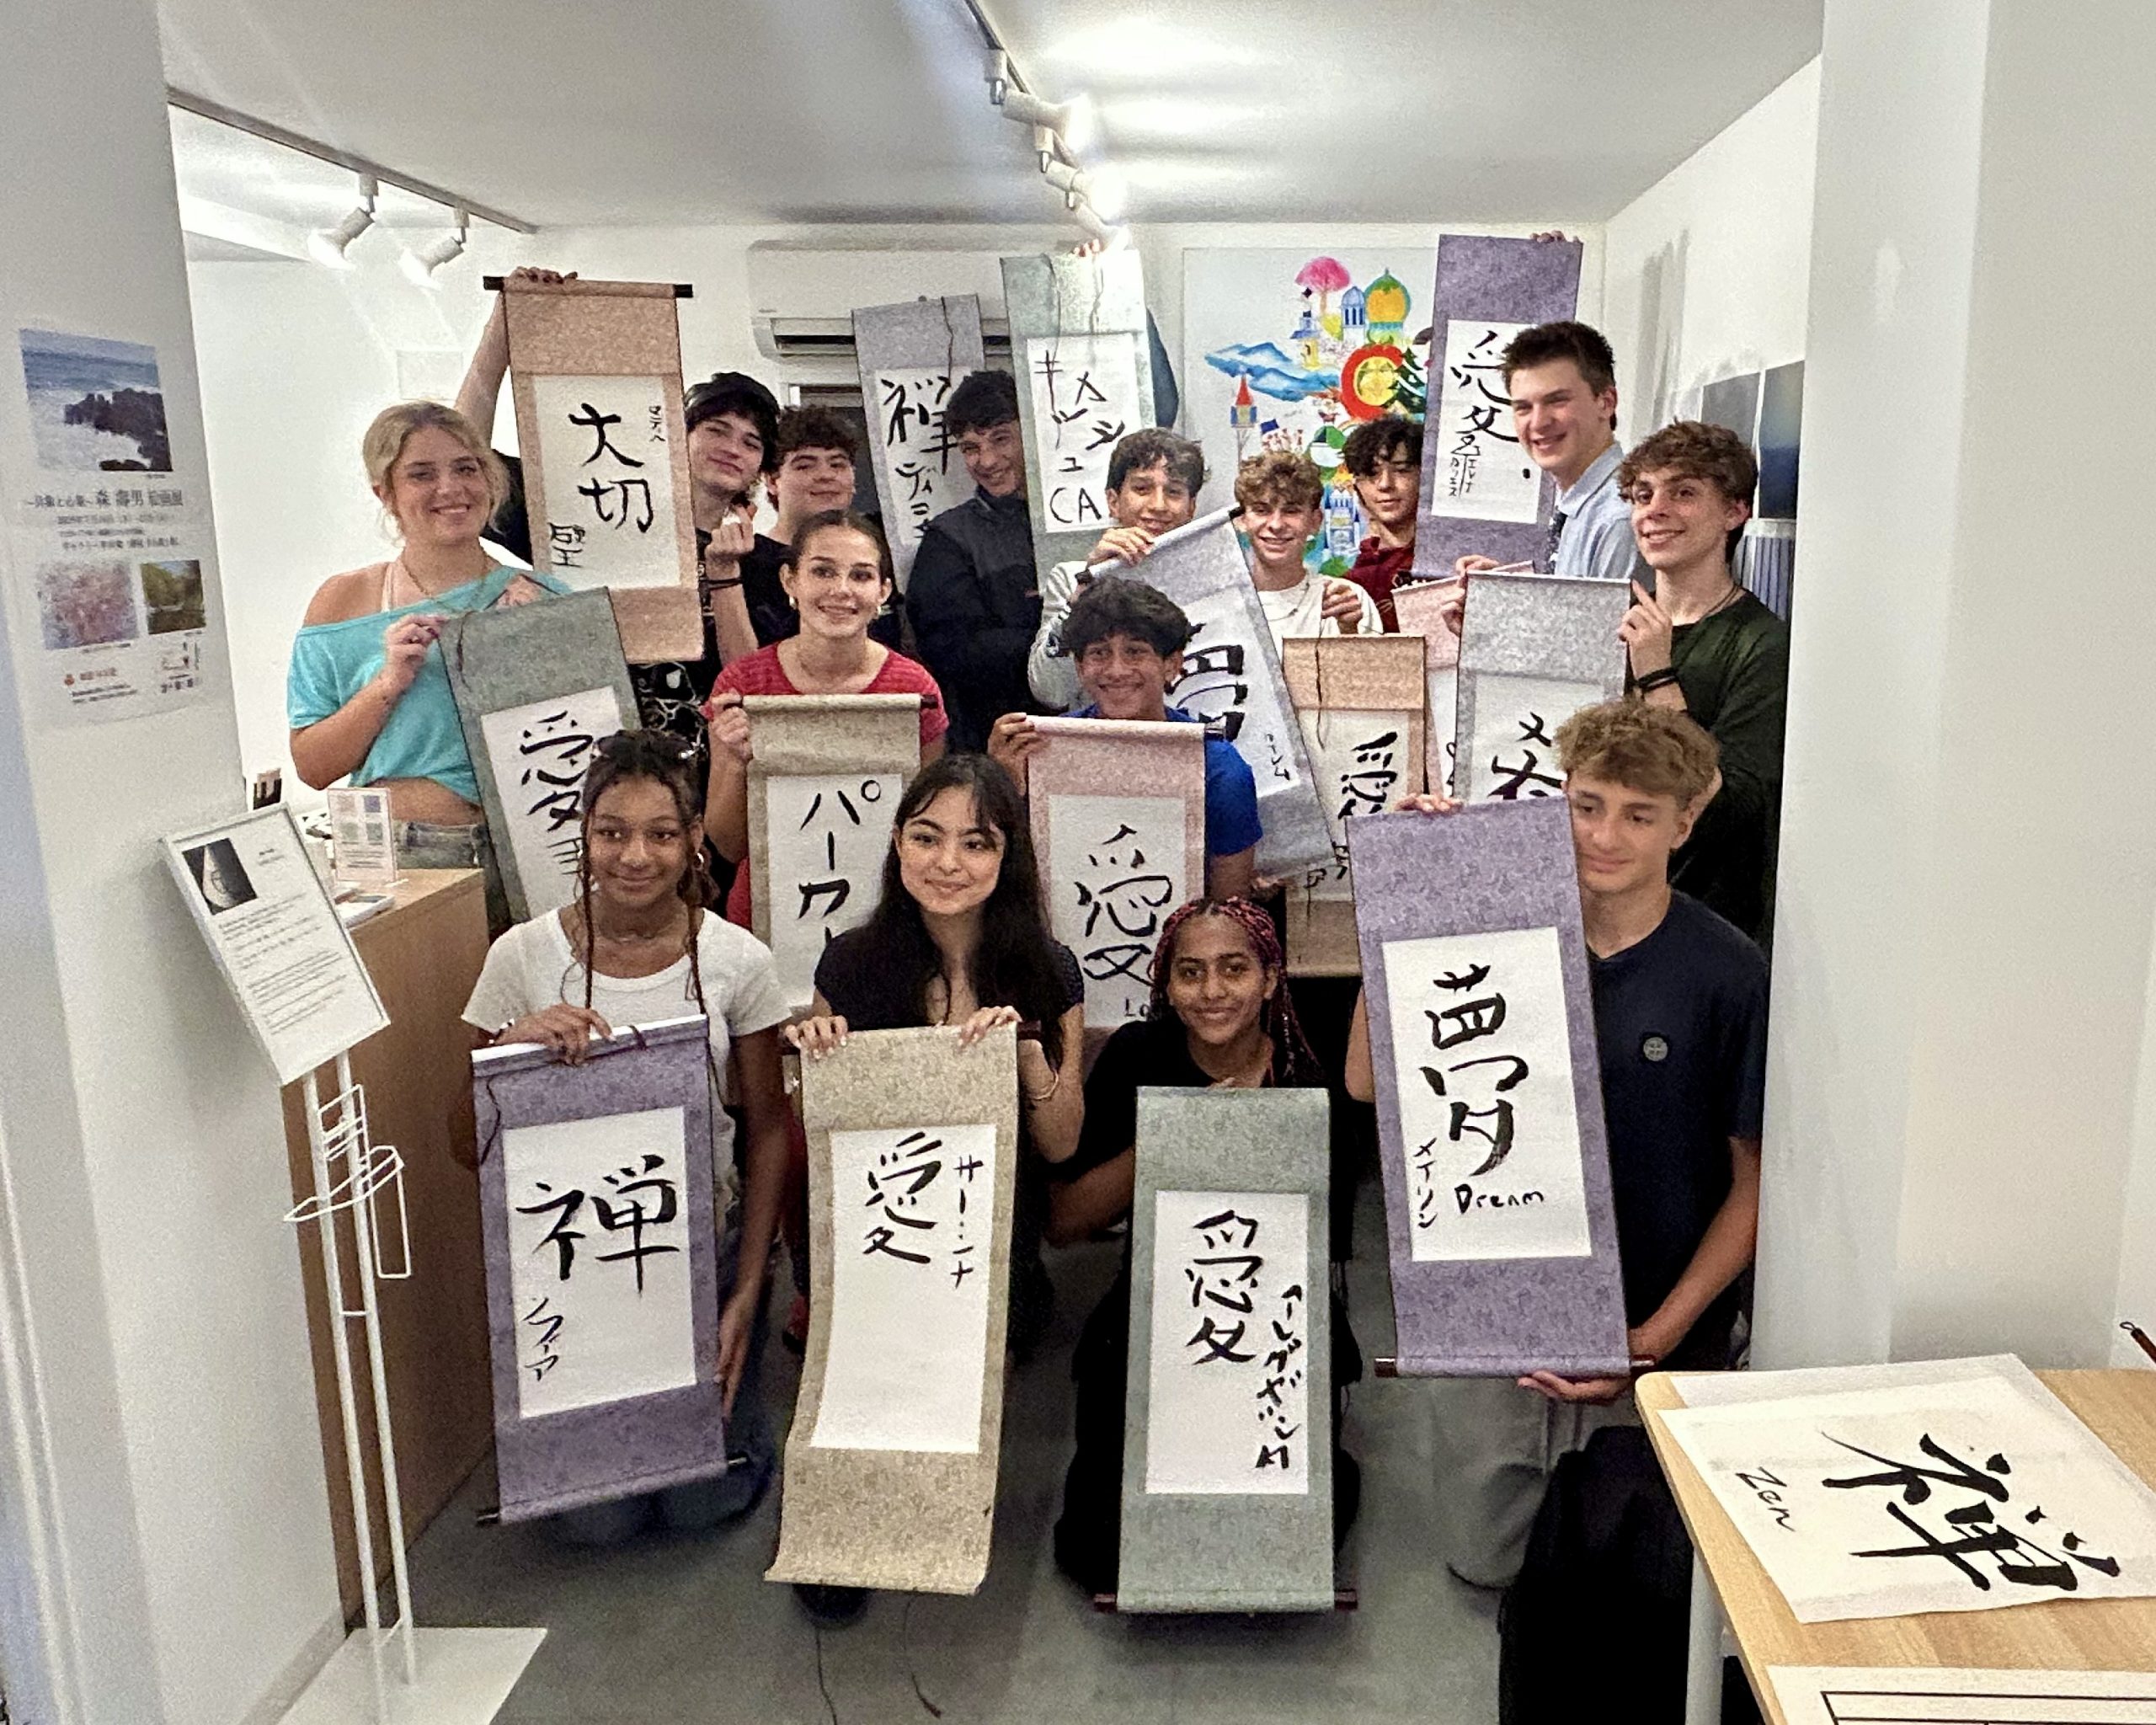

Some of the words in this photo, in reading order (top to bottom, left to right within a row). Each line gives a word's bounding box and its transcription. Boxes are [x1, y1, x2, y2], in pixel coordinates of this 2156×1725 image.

[568, 403, 654, 533] 大切
[1049, 487, 1102, 524] CA
[1075, 823, 1172, 985] 愛
[1123, 998, 1150, 1017] Lo
[1419, 964, 1529, 1176] 夢
[515, 1154, 680, 1295] 禅
[862, 1131, 942, 1263] 愛
[1454, 1183, 1545, 1215] Dream
[1184, 1210, 1263, 1366] 愛
[1735, 1466, 1796, 1532] Zen
[1821, 1433, 2121, 1592] 禅
